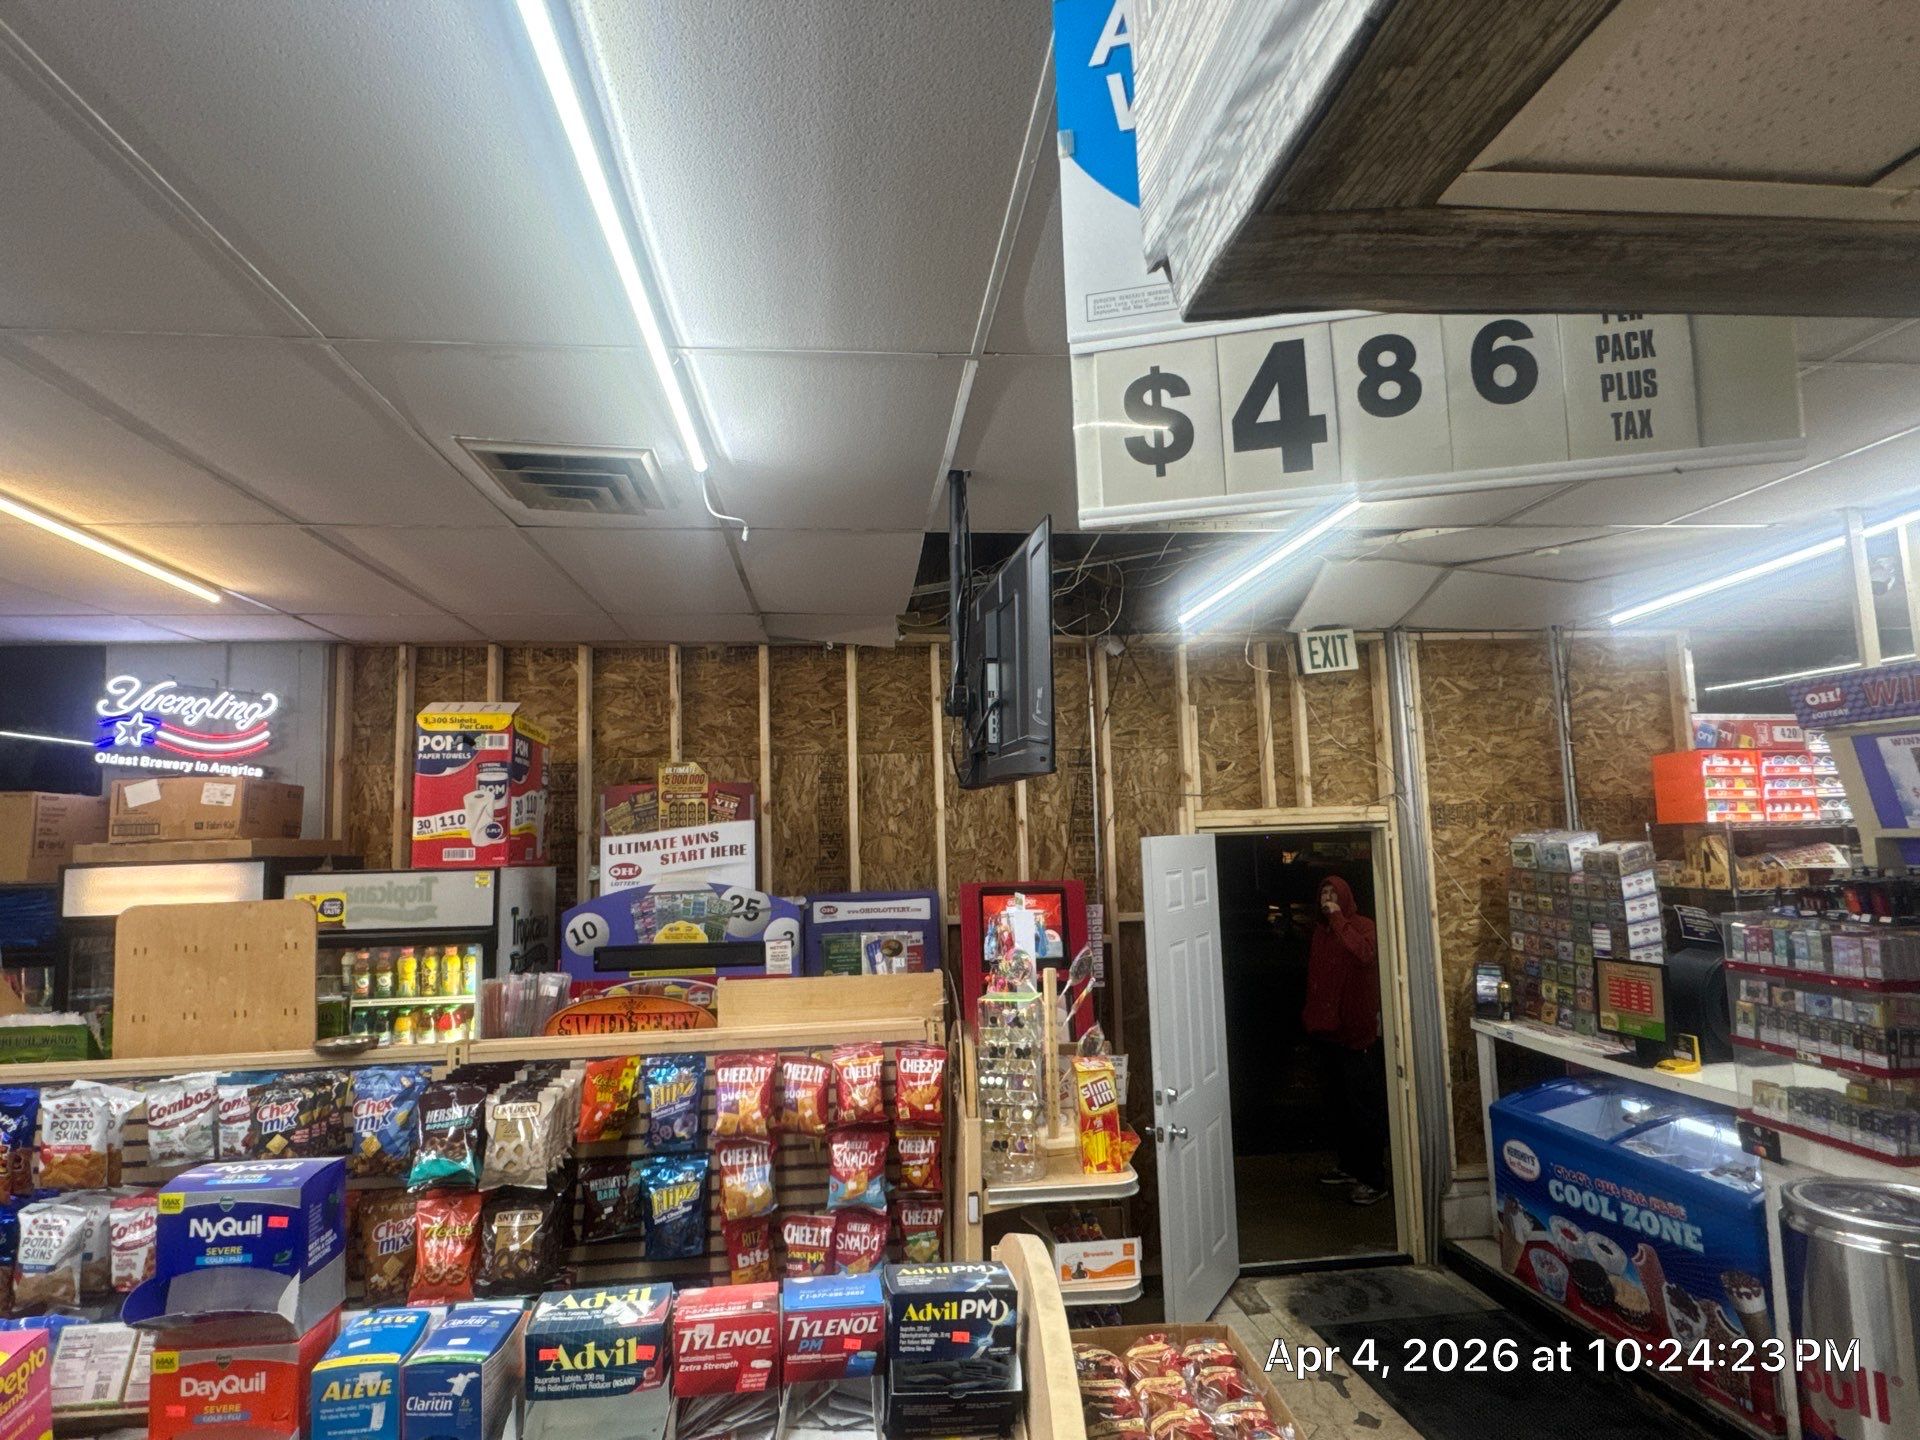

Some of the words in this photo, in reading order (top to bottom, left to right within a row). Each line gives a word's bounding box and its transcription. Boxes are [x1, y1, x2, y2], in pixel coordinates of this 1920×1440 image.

[1595, 329, 1656, 364] PACK
[1600, 368, 1658, 402] PLUS
[1611, 409, 1653, 441] TAX
[1307, 634, 1349, 670] EXIT
[1863, 674, 1920, 708] WI
[97, 675, 278, 731] Yuengling
[1811, 707, 1849, 720] LOTTERY
[449, 716, 478, 725] Sheets
[418, 734, 464, 751] POM
[95, 752, 139, 767] Oldest
[140, 756, 192, 772] Brewery
[210, 762, 263, 777] America
[442, 752, 472, 760] TOWELS
[417, 818, 431, 830] 30
[440, 813, 466, 828] 110
[608, 836, 678, 856] ULTIMATE
[682, 830, 719, 847] WINS
[660, 848, 707, 866] START
[711, 843, 747, 858] HERE
[609, 864, 640, 877] OH!
[729, 895, 761, 921] 25
[569, 920, 598, 947] 10
[631, 1010, 701, 1033] BERRY
[148, 1087, 214, 1122] Combos
[257, 1098, 301, 1122] Chex
[353, 1097, 395, 1118] Chex
[51, 1119, 94, 1131] POTATO
[262, 1114, 298, 1135] mix
[355, 1111, 393, 1133] mix
[55, 1130, 88, 1141] SKINS
[215, 1161, 305, 1174] NyQuil
[162, 1197, 180, 1206] MAX
[497, 1211, 540, 1223] SNYER'S
[1549, 1178, 1618, 1222] COOL
[1620, 1202, 1705, 1253] ZONE
[189, 1214, 263, 1243] NyQuil
[372, 1216, 416, 1241] Chex
[741, 1230, 761, 1248] RITZ
[21, 1236, 63, 1250] POTATO
[23, 1248, 53, 1260] SKINS
[205, 1245, 244, 1257] SEVERE
[378, 1232, 413, 1256] mix
[737, 1248, 770, 1269] bits
[897, 1266, 950, 1275] Advil
[951, 1265, 987, 1275] PM
[554, 1286, 652, 1310] Advil
[901, 1300, 959, 1322] Advil
[960, 1299, 998, 1320] PM
[788, 1315, 880, 1341] TYLENOL
[678, 1327, 774, 1354] TYLENOL
[798, 1338, 825, 1353] PM
[155, 1357, 175, 1366] MAX
[545, 1336, 639, 1372] Advil
[679, 1361, 703, 1373] Extra
[703, 1359, 739, 1372] Strength
[180, 1370, 266, 1401] DayQuil
[320, 1378, 393, 1402] ALEVE
[534, 1384, 547, 1392] Pain
[588, 1380, 612, 1390] Reducer
[612, 1376, 637, 1389] (NSAID)
[203, 1403, 242, 1415] SEVERE
[406, 1396, 453, 1412] Claritin
